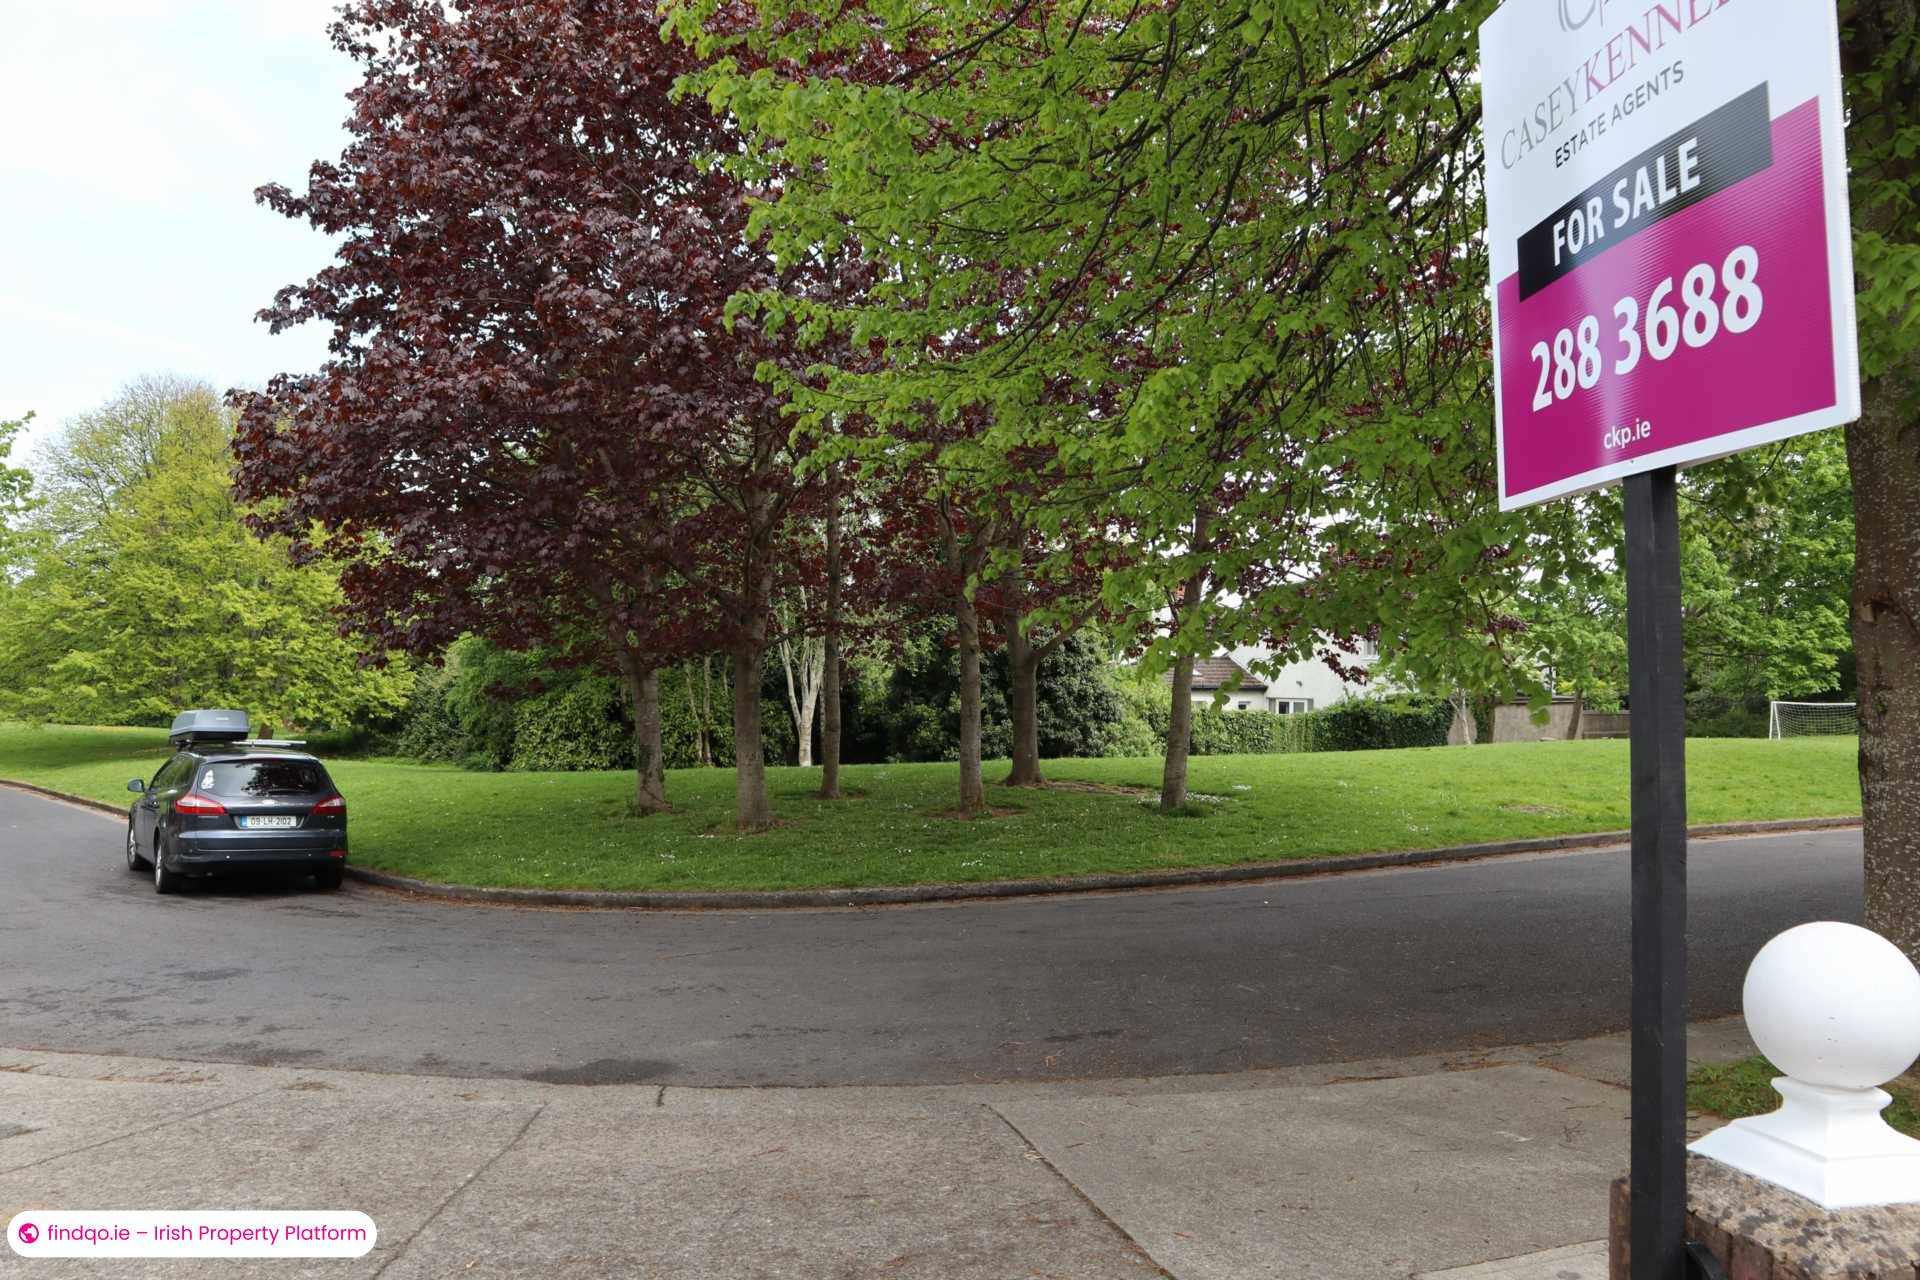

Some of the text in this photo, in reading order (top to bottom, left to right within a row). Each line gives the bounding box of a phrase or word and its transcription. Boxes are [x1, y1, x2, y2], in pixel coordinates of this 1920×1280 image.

[1500, 0, 1730, 170] CASEYKENN
[1555, 60, 1684, 168] ESTATE AGENTS
[1552, 136, 1701, 267] FOR SALE
[1531, 245, 1764, 412] 288 3688
[1603, 417, 1651, 452] ckp.ie
